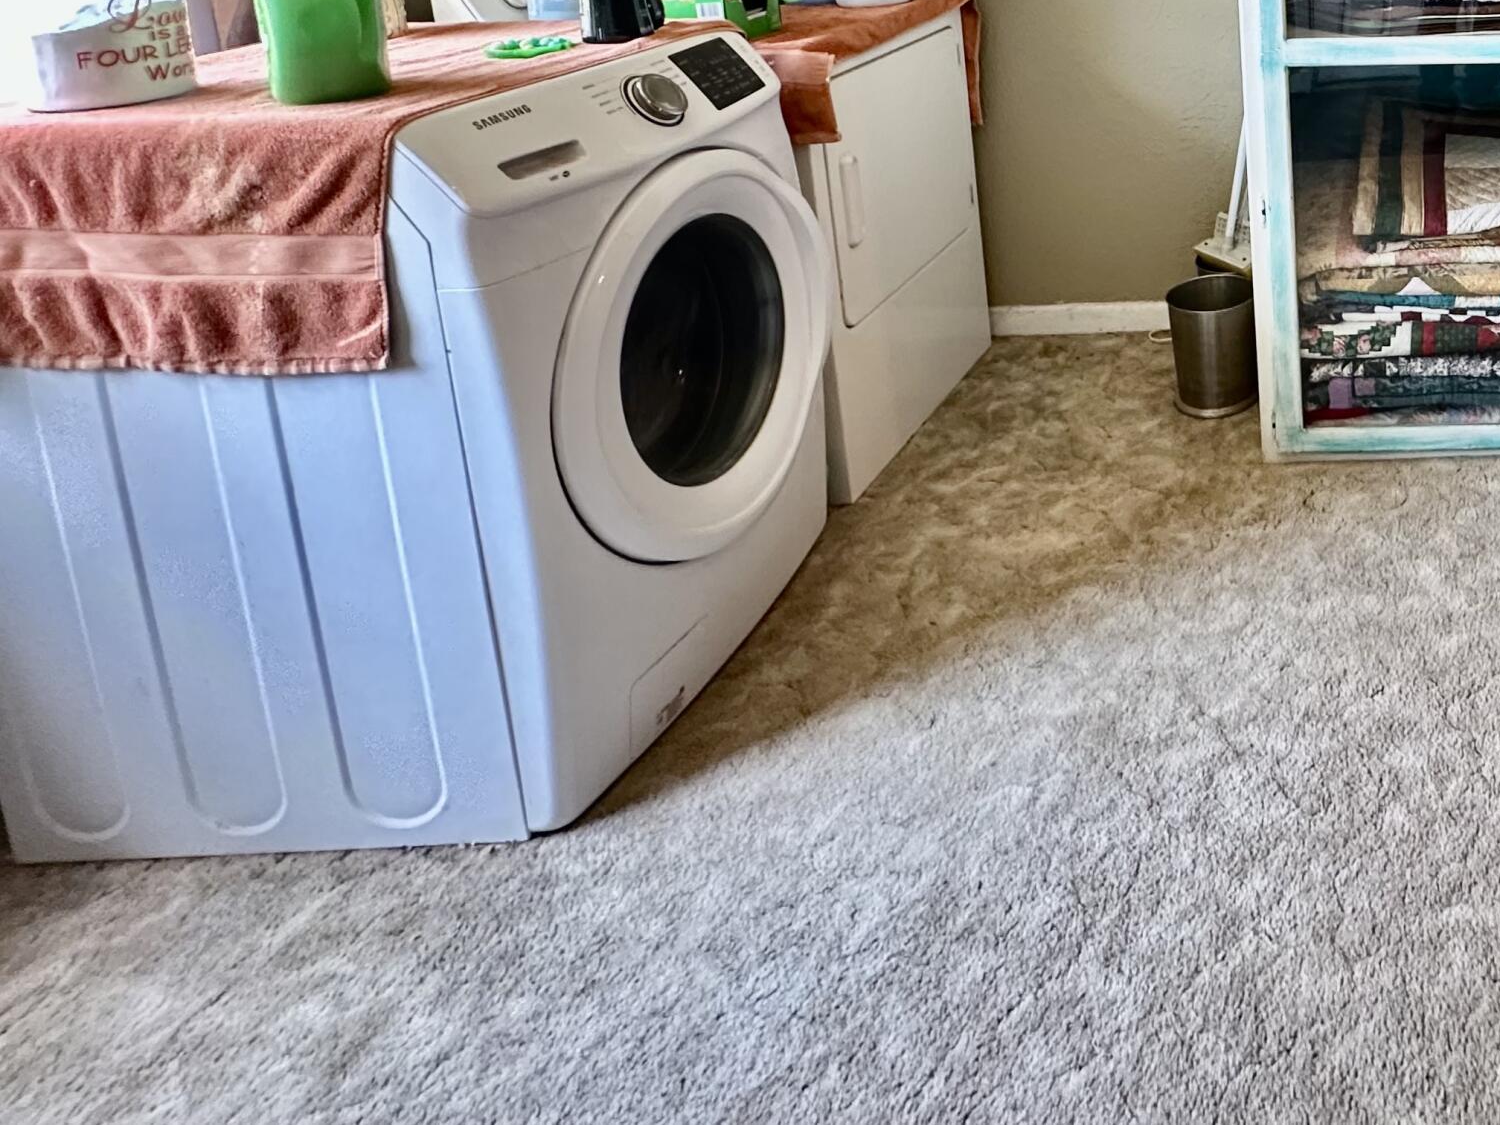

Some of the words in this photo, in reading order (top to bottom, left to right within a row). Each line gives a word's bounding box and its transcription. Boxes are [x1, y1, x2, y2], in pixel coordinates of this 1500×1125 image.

[149, 28, 172, 41] is
[76, 44, 158, 70] FOUR
[472, 104, 532, 131] SAMSUNG
